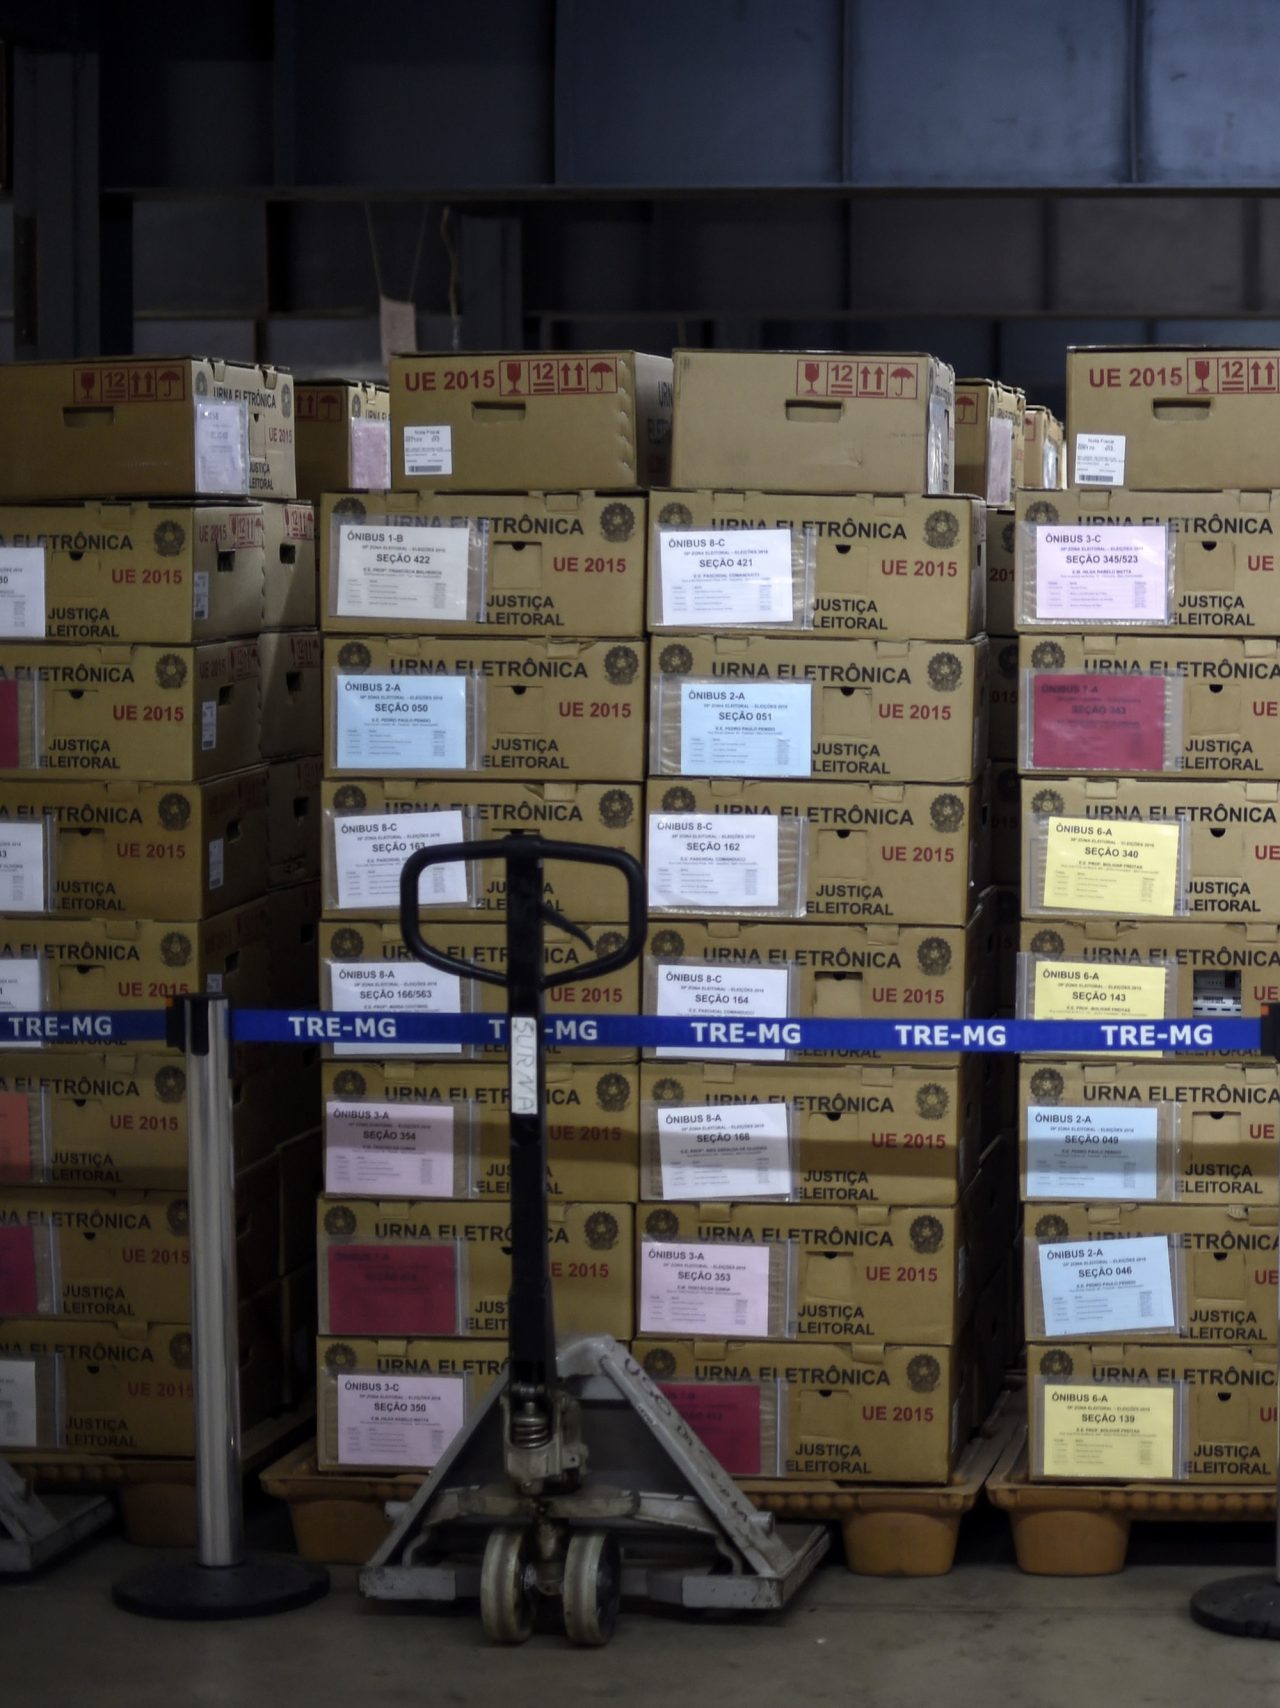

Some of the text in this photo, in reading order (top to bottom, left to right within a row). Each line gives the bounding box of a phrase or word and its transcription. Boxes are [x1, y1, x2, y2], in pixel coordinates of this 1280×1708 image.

[532, 363, 554, 380] 12
[831, 365, 852, 382] 12
[1222, 361, 1244, 378] 12
[405, 370, 495, 391] UE 2015
[1090, 367, 1182, 387] UE 2015
[347, 531, 403, 542] ÔNIBUS 1-B
[669, 538, 725, 548] ÔNIBUS 8-C
[1046, 533, 1101, 543] ÔNIBUS 3-C
[376, 554, 430, 565] SEÇÃO 422
[554, 557, 626, 572] UE 2015
[699, 558, 753, 569] SEÇÃO 421
[1066, 554, 1138, 564] SEÇÃO 345/523
[882, 560, 957, 576] UE 2015
[112, 569, 182, 584] UE 2015
[1179, 596, 1244, 609] JUSTIÇA
[48, 608, 110, 622] JUSTIÇA
[375, 703, 428, 713] SEÇÃO 050
[1253, 702, 1278, 716] UE
[718, 711, 772, 722] SEÇÃO 051
[492, 739, 558, 754] JUSTIÇA
[1056, 824, 1112, 836] ÔNIBUS 6-A
[117, 844, 185, 858] UE 2015
[372, 843, 407, 853] SEÇÃO
[686, 842, 740, 852] SEÇÃO 162
[1085, 847, 1138, 858] SEÇÃO 340
[1255, 845, 1280, 860] UE
[816, 885, 883, 899] JUSTIÇA
[806, 902, 893, 916] ELEITORAL
[360, 990, 432, 1000] SEÇÃO 166/563
[695, 994, 749, 1004] SEÇÃO 164
[1073, 991, 1126, 1001] SEÇÃO 143
[8, 1016, 112, 1036] TRE-MG
[288, 1016, 396, 1038] TRE-MG
[489, 1020, 598, 1040] T-MG
[690, 1022, 801, 1044] TRE-MG
[895, 1025, 1006, 1045] TRE-MG
[1101, 1025, 1213, 1046] TRE-MG
[1084, 1083, 1280, 1104] URNA ELETRÔNICA
[110, 1115, 178, 1130] UE 2015
[1035, 1113, 1091, 1124] ÔNIBUS 2-A
[363, 1131, 416, 1141] SEÇÃO 354
[697, 1133, 731, 1143] SEÇÃO
[1065, 1135, 1118, 1145] SEÇÃO 049
[678, 1271, 731, 1282] SEÇÃO 353
[866, 1266, 937, 1282] UE 2015
[1078, 1267, 1132, 1279] SEÇÃO 046
[345, 1381, 399, 1392] ÔNIBUS 3-C
[374, 1402, 426, 1412] SEÇÃO 350
[1082, 1413, 1135, 1424] SEÇÃO 139
[795, 1444, 861, 1458] JUSTIÇA
[1184, 1462, 1271, 1475] ELEITORAL
